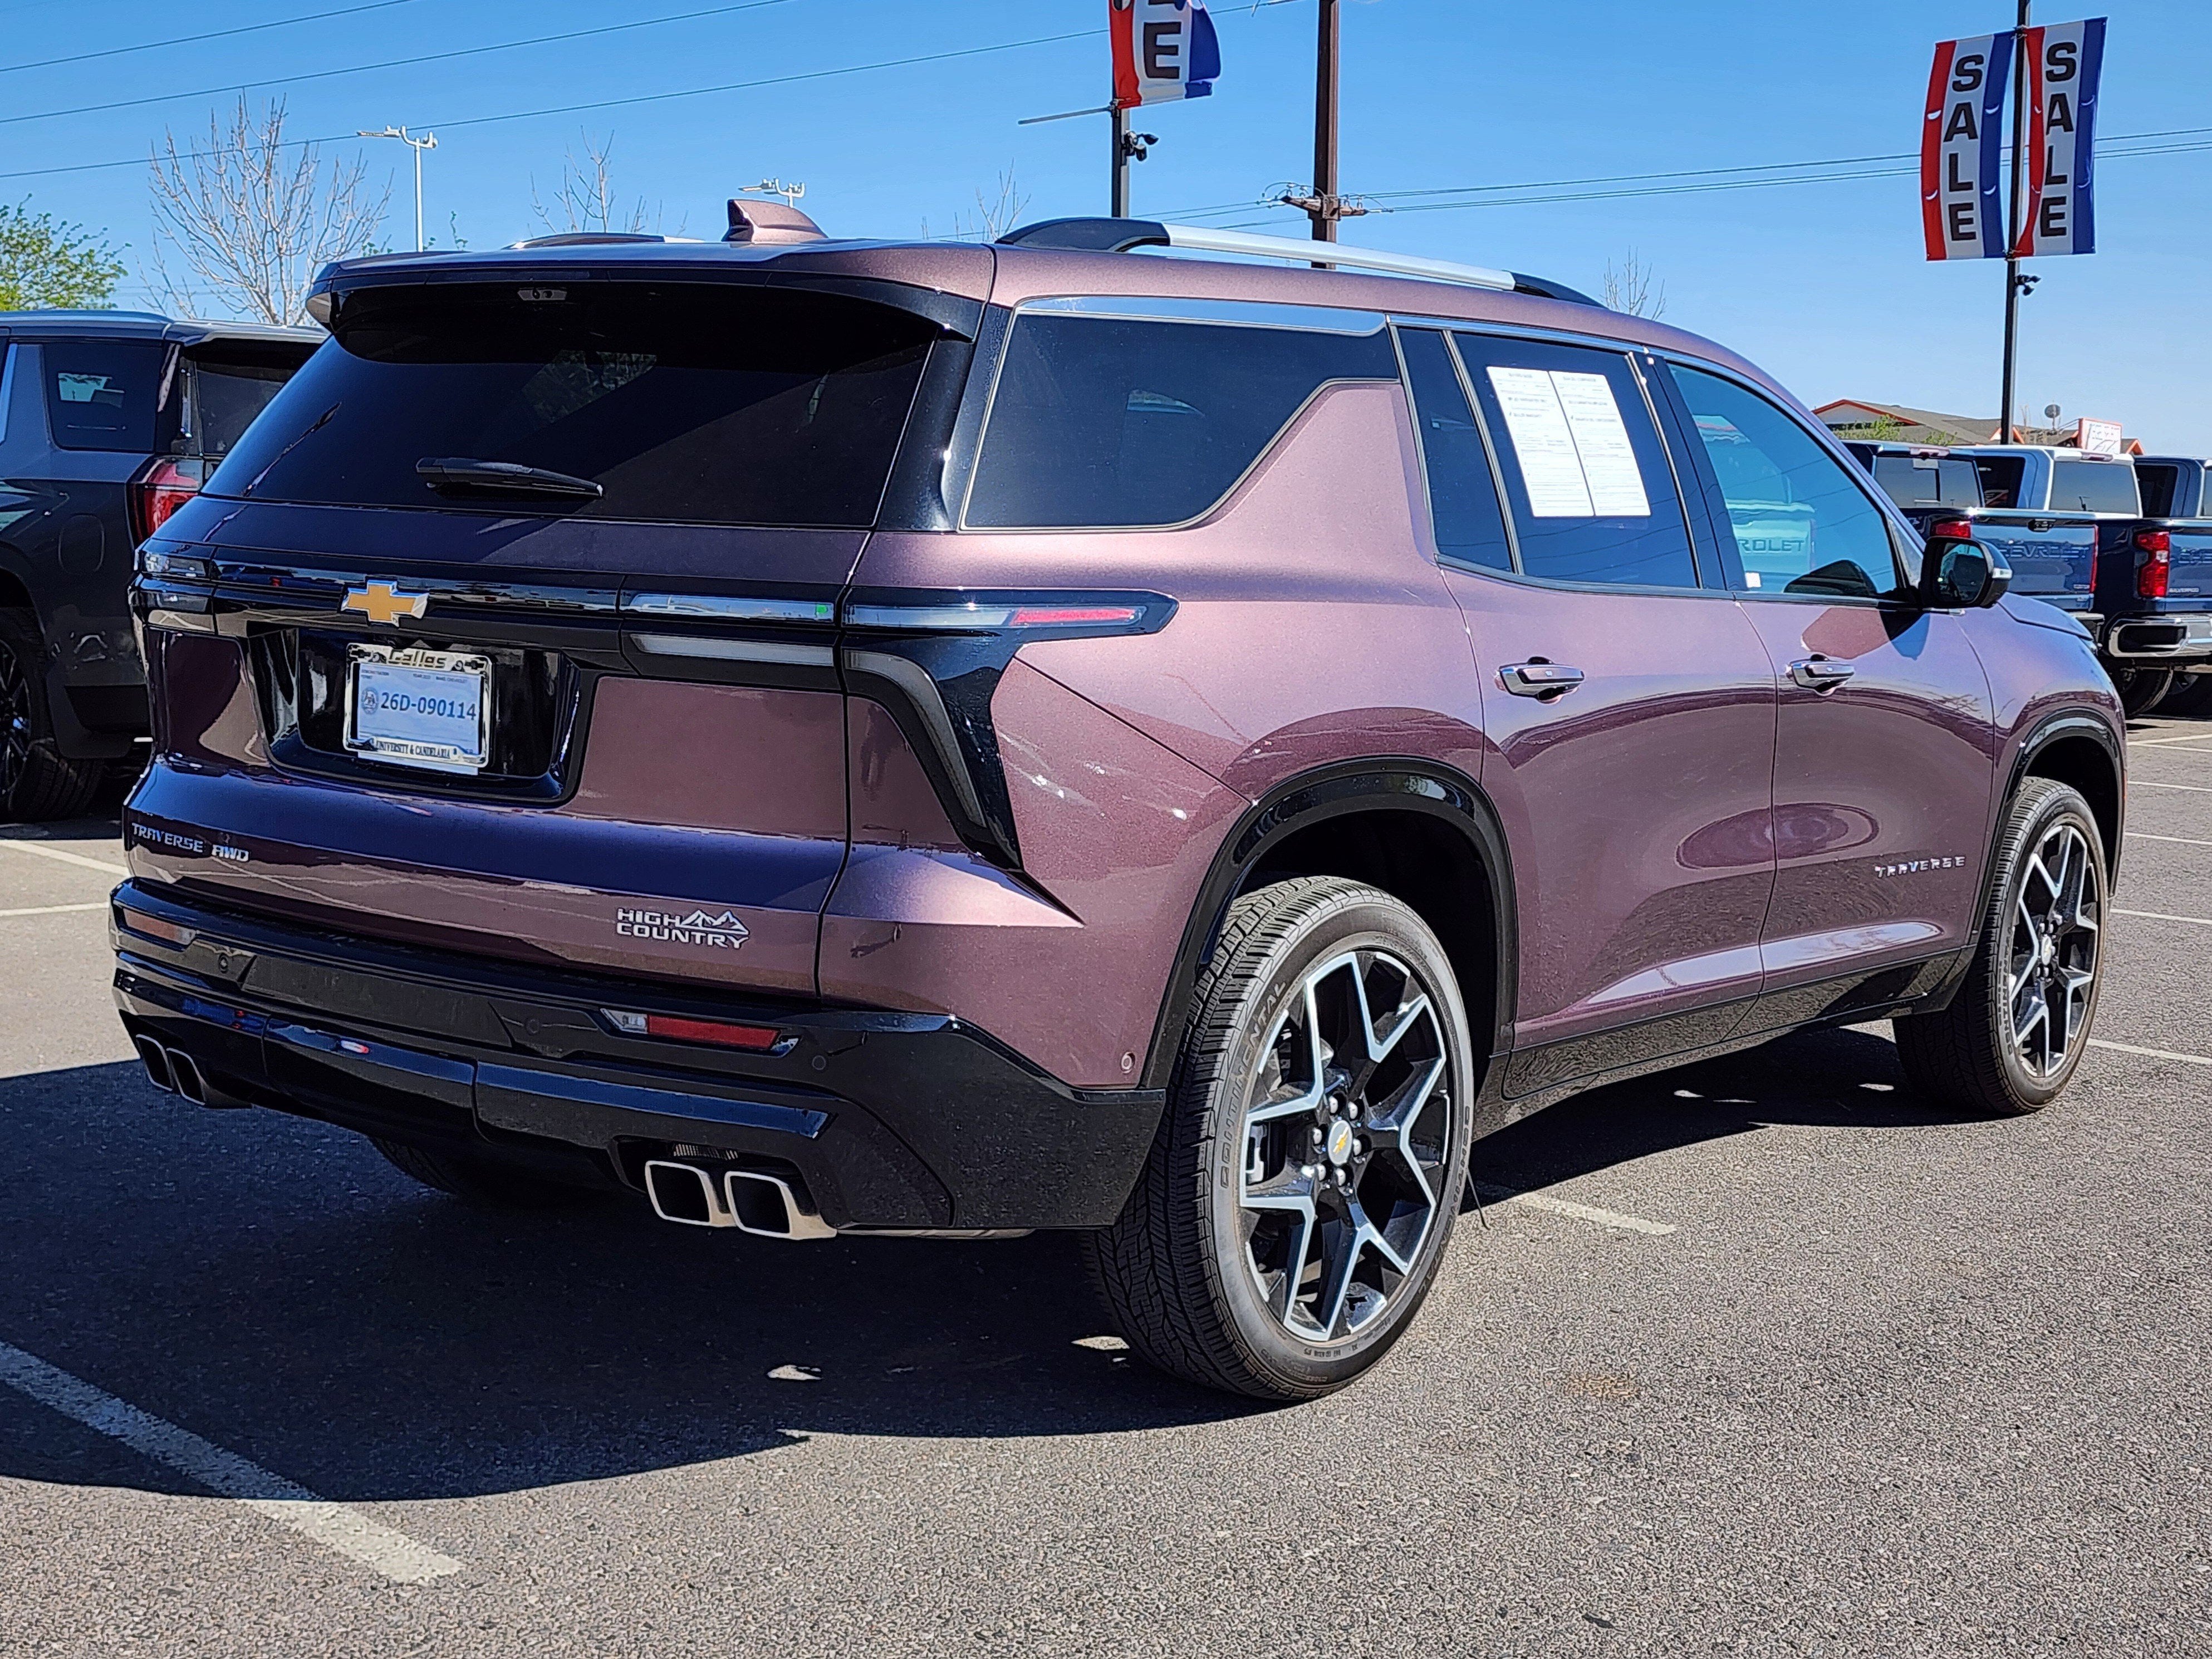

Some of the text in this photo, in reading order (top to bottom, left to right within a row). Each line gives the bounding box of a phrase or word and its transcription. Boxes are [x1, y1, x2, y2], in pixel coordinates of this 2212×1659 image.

[1943, 53, 1985, 241] SALE
[2040, 41, 2078, 237] SALE
[381, 692, 477, 720] 26D-090114
[131, 822, 249, 862] TRAVERSE AWD
[1875, 856, 1965, 878] TRAVERSE
[617, 907, 681, 927] HIGH
[616, 922, 749, 949] COUNTRY
